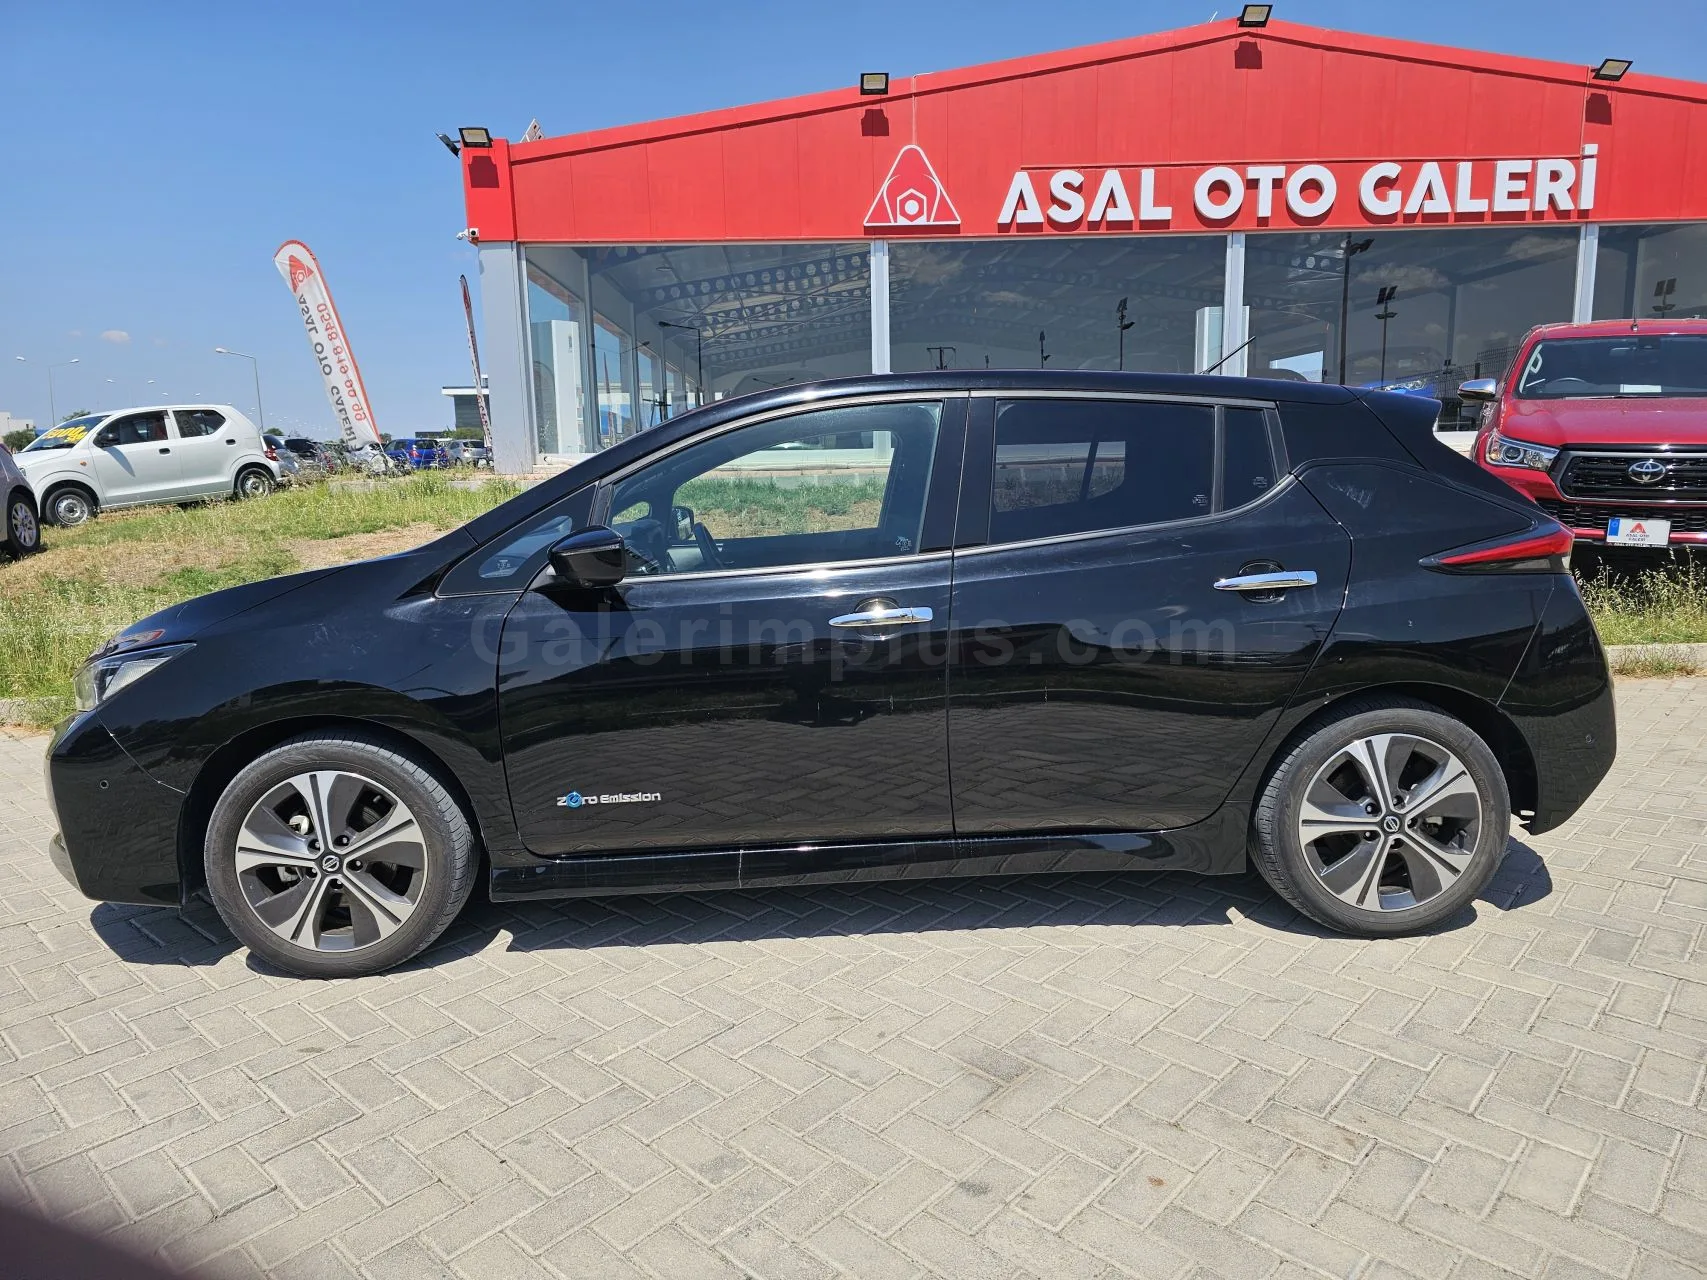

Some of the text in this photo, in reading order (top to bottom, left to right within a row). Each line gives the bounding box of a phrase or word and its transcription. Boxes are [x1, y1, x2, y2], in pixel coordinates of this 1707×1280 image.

[997, 143, 1599, 224] ASAL OTO GALERİ
[600, 792, 661, 804] Emission
